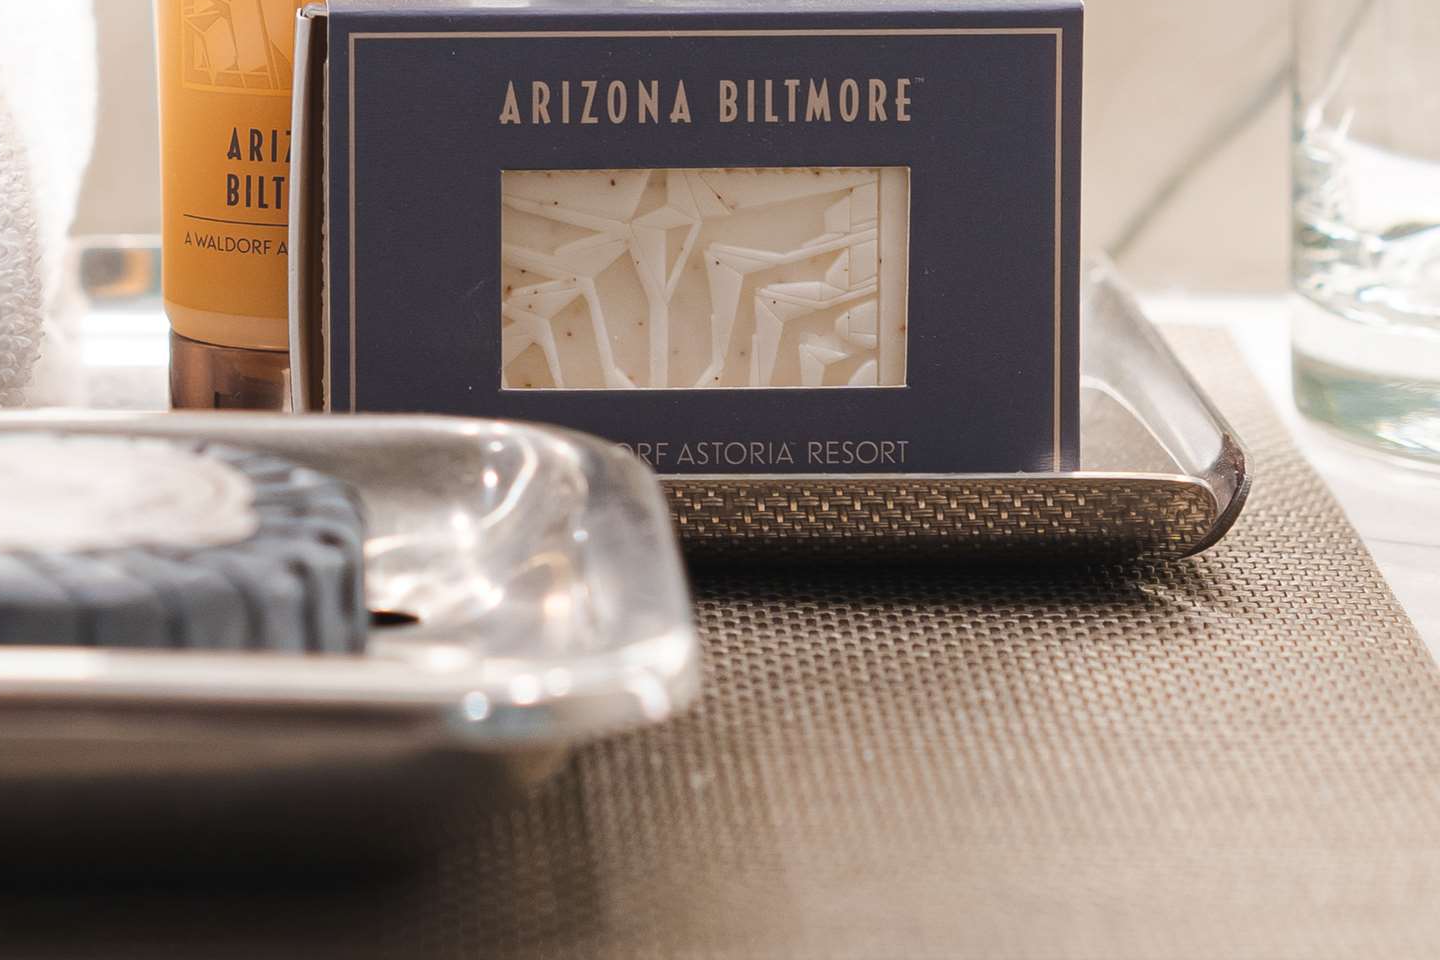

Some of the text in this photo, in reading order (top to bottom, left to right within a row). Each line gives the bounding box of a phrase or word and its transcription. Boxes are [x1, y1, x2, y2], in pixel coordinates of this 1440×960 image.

[499, 80, 692, 125] ARIZONA
[184, 231, 192, 245] A
[195, 232, 272, 255] WALDORF
[616, 441, 909, 465] RF ASTORIA RESORT
